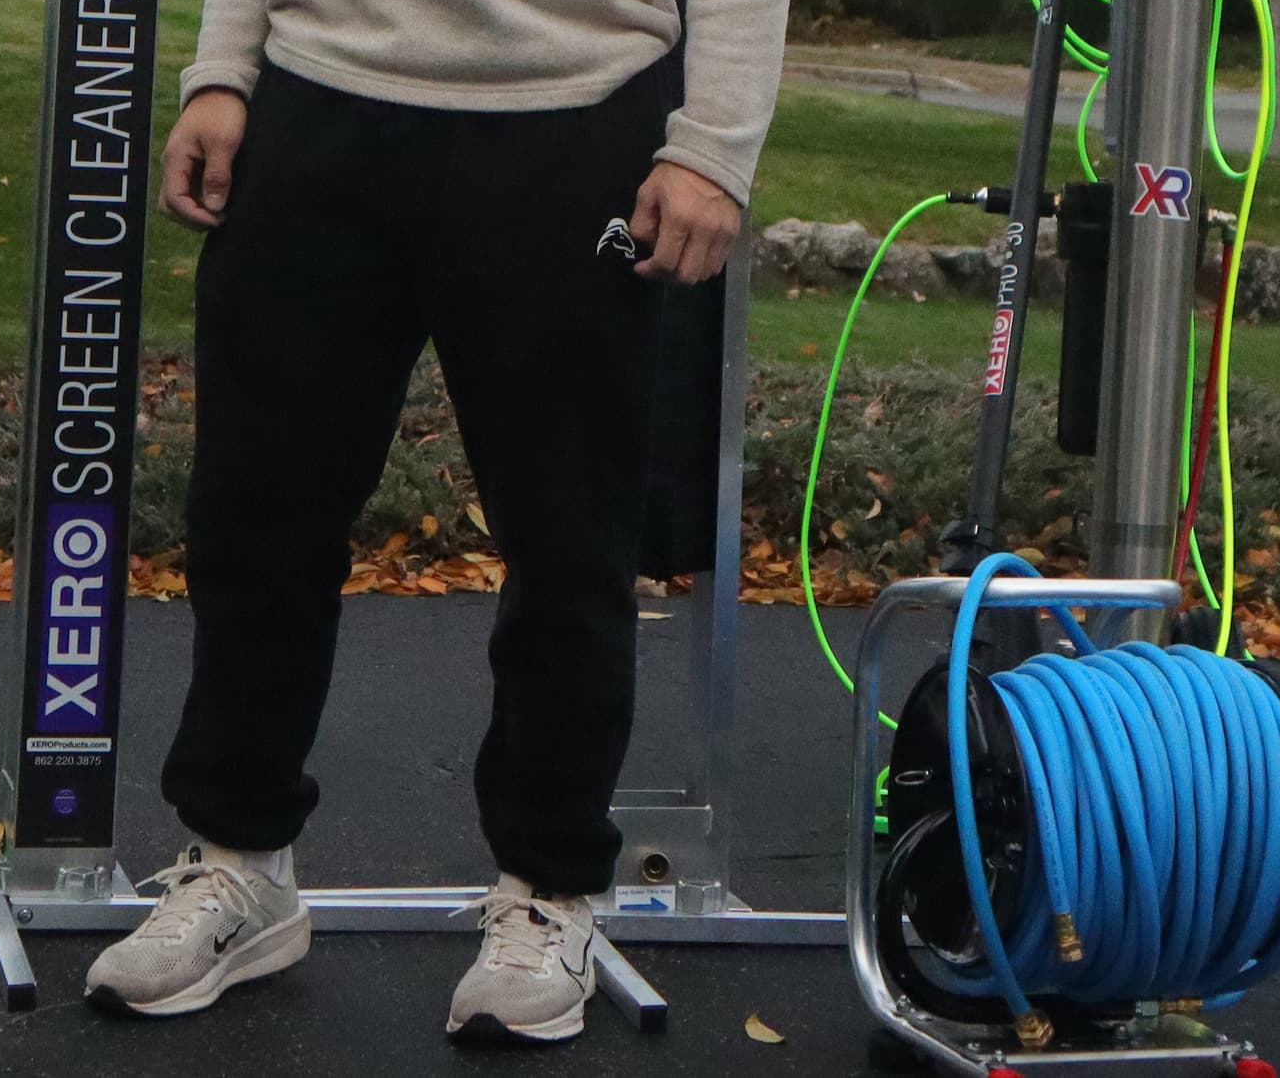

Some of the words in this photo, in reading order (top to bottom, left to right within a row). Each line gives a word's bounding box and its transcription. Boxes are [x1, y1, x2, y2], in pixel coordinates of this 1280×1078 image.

[1130, 163, 1192, 220] XR
[52, 269, 122, 496] SCREEN
[45, 519, 107, 716] XERO
[31, 740, 107, 750] XEROProducts.com
[34, 756, 53, 766] 862
[56, 756, 74, 766] 220
[77, 756, 102, 766] 3875
